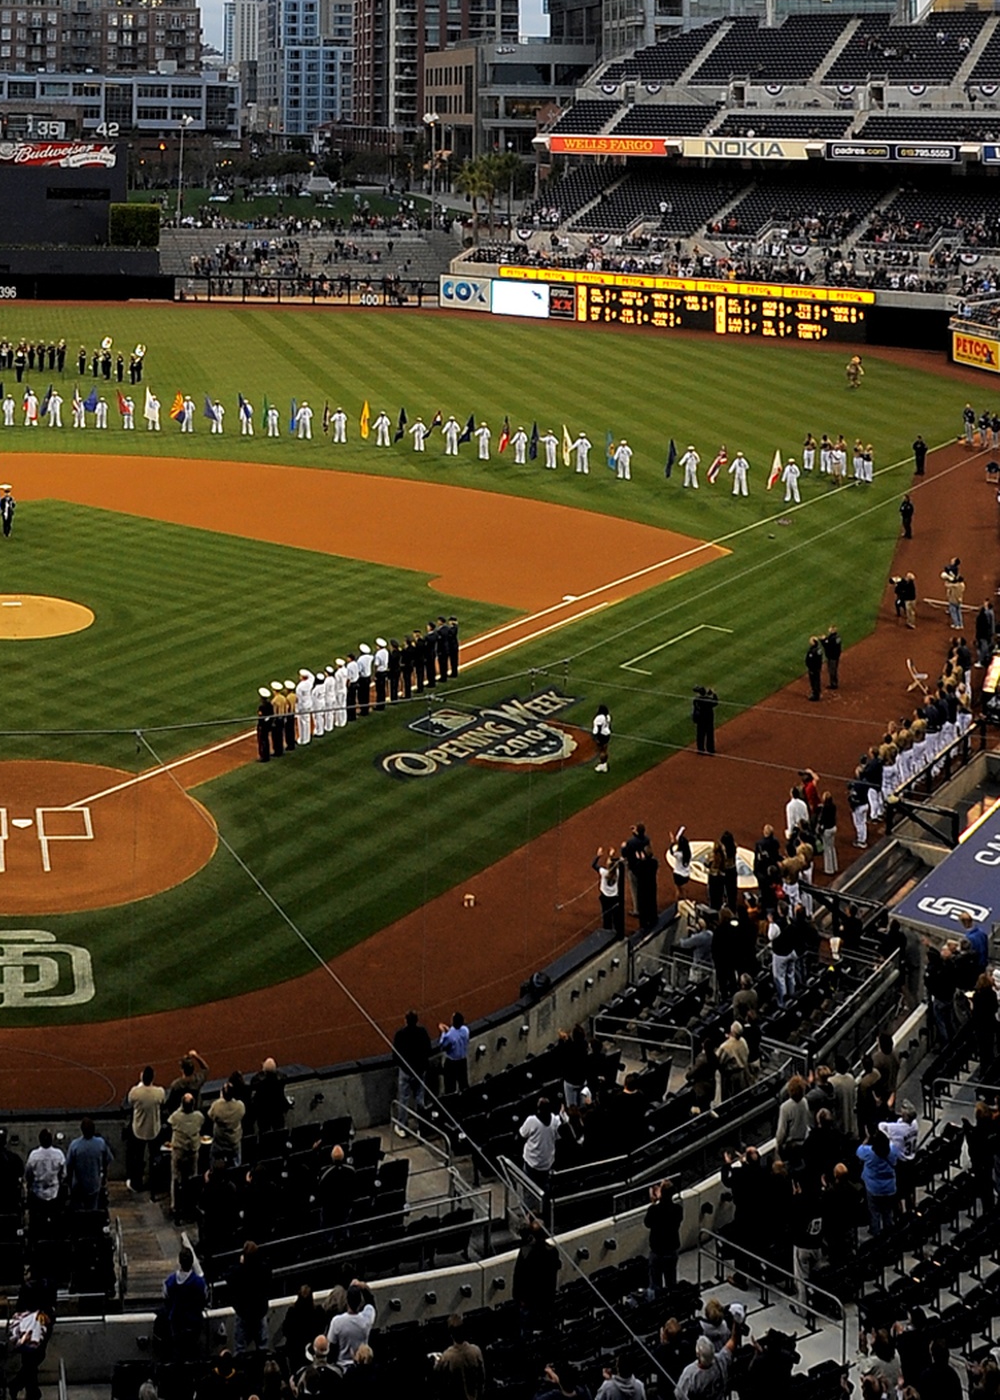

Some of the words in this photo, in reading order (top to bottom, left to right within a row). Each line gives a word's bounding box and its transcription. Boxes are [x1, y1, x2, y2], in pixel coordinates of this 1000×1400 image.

[38, 121, 59, 136] 35
[96, 122, 119, 137] 42
[564, 138, 607, 150] WELLS
[610, 140, 653, 151] FARGO
[705, 142, 784, 157] NOKIA
[834, 148, 886, 156] padres.com
[14, 143, 94, 162] Budweiser
[443, 280, 488, 303] COX
[360, 295, 379, 305] 400
[552, 299, 572, 310] XX
[956, 337, 989, 358] PETCO
[382, 720, 517, 776] OPENING
[480, 690, 576, 725] WEEK
[496, 728, 541, 756] 2010
